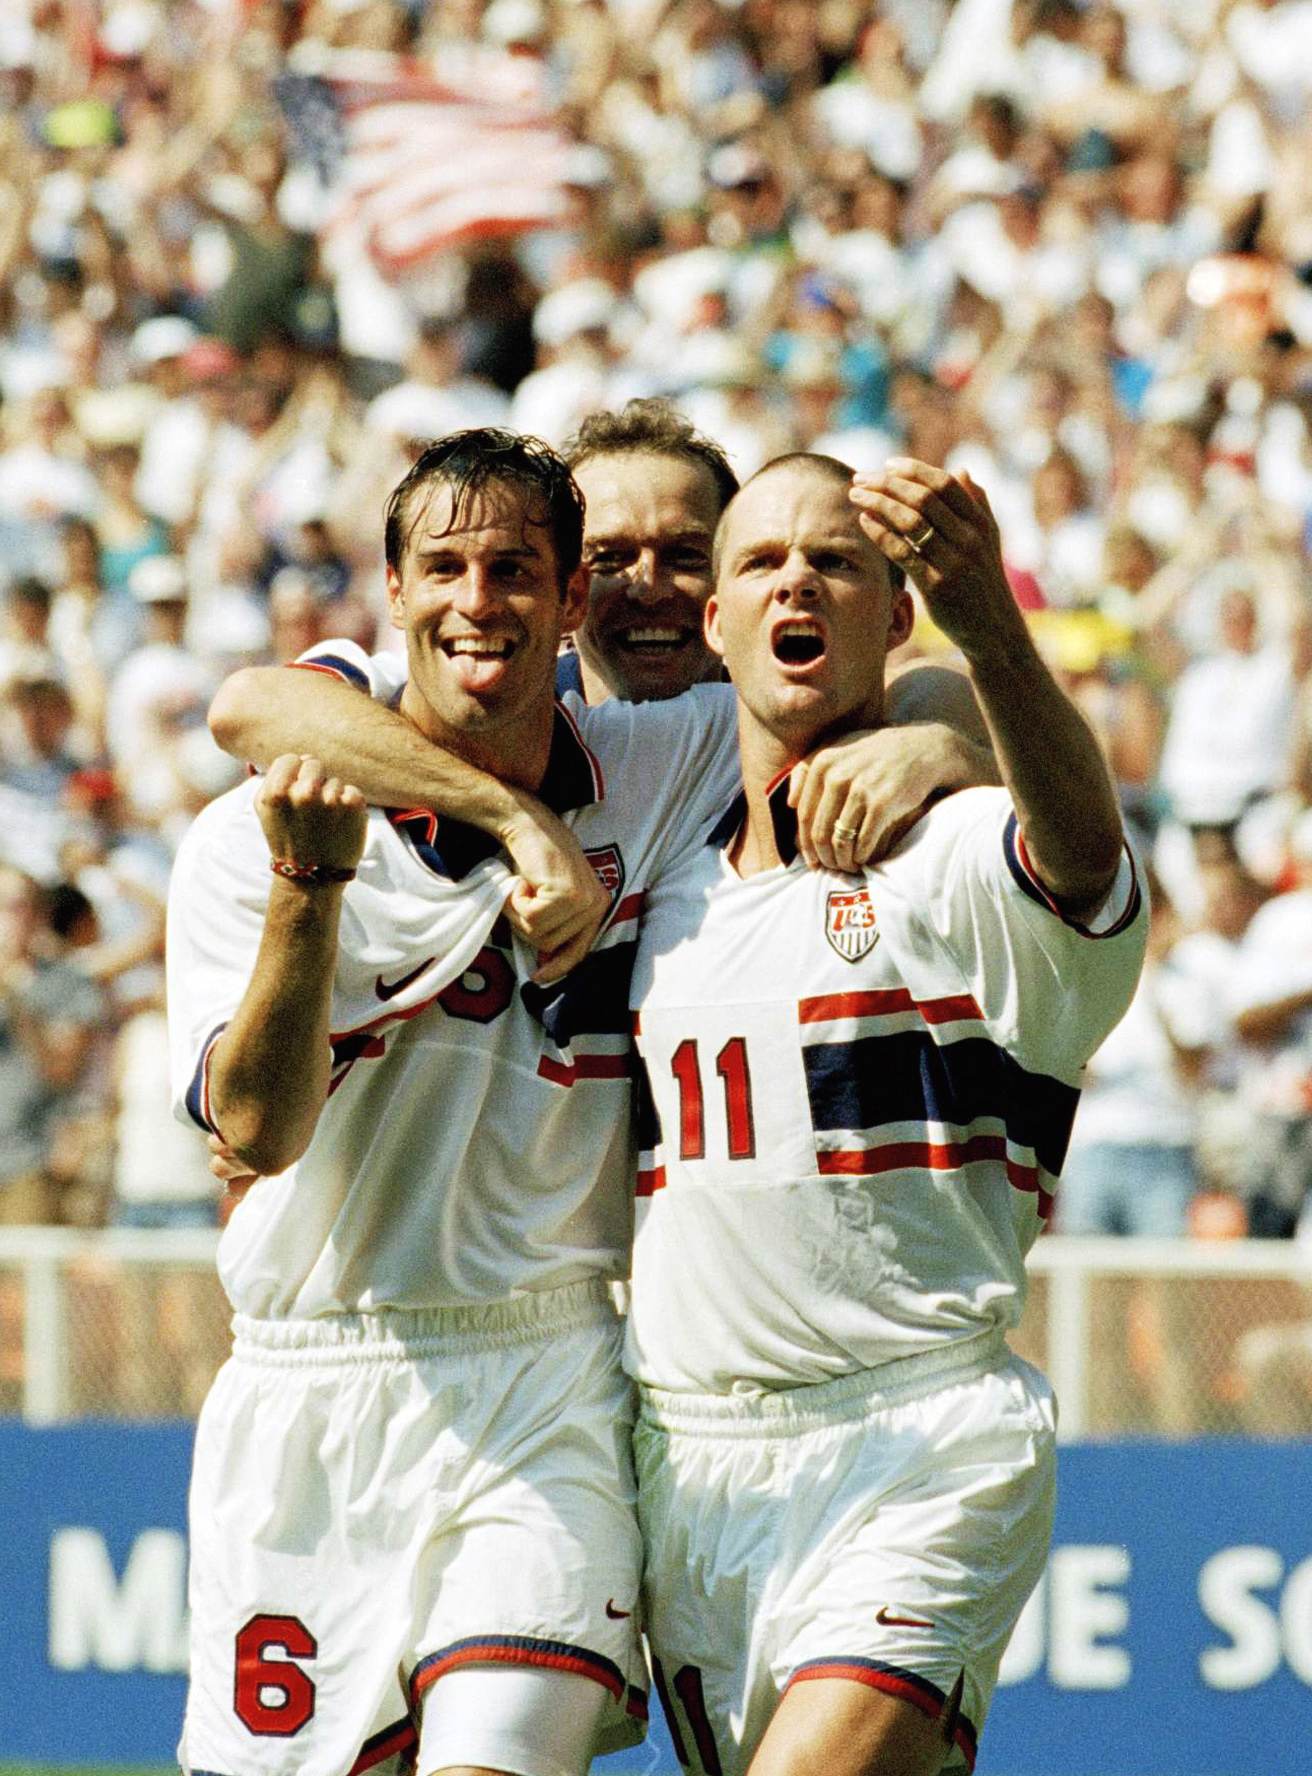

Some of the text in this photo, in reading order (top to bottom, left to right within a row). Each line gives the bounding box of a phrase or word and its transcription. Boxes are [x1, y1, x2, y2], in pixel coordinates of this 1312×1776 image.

[670, 1036, 756, 1160] 11
[48, 1526, 191, 1673] M
[234, 1613, 318, 1737] 6
